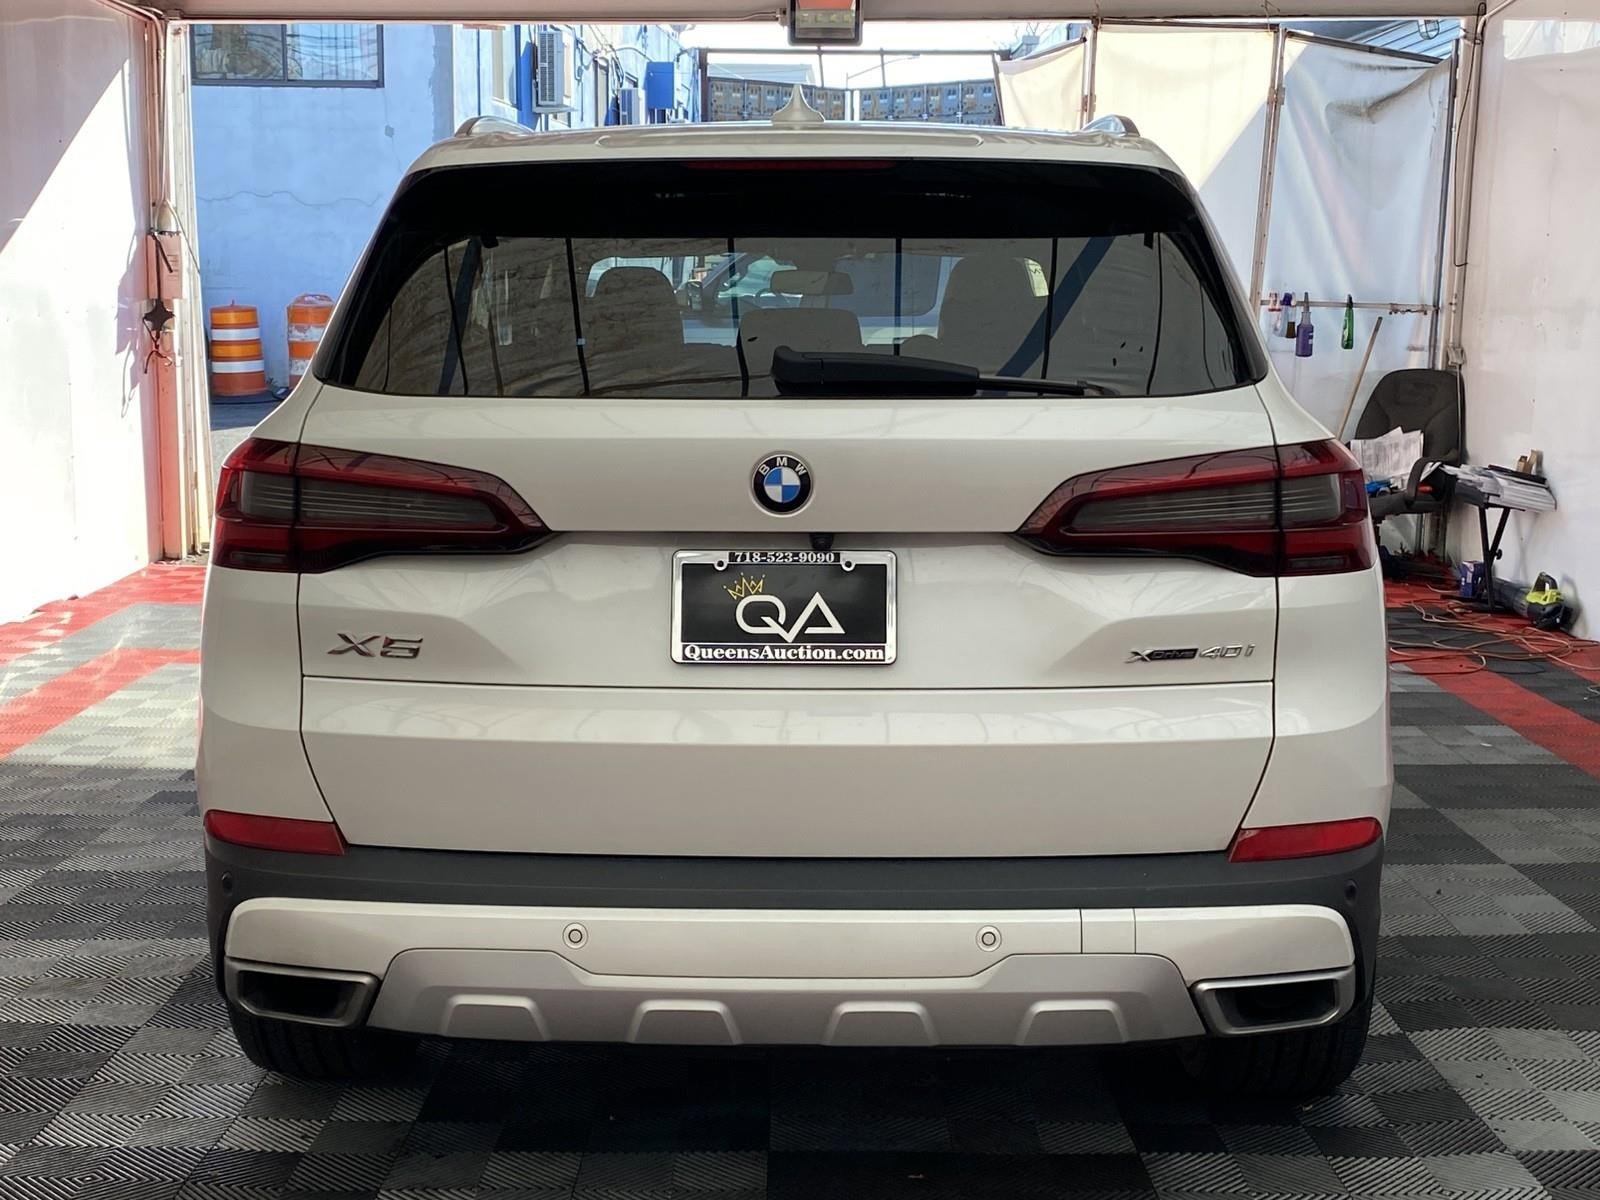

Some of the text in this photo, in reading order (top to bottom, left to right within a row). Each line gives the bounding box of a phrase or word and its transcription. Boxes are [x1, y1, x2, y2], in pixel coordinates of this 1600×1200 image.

[758, 457, 807, 475] BMW
[735, 552, 835, 563] 718-523-9090
[735, 592, 846, 643] QA
[326, 632, 424, 659] X5
[683, 644, 884, 660] QueensAuction.com
